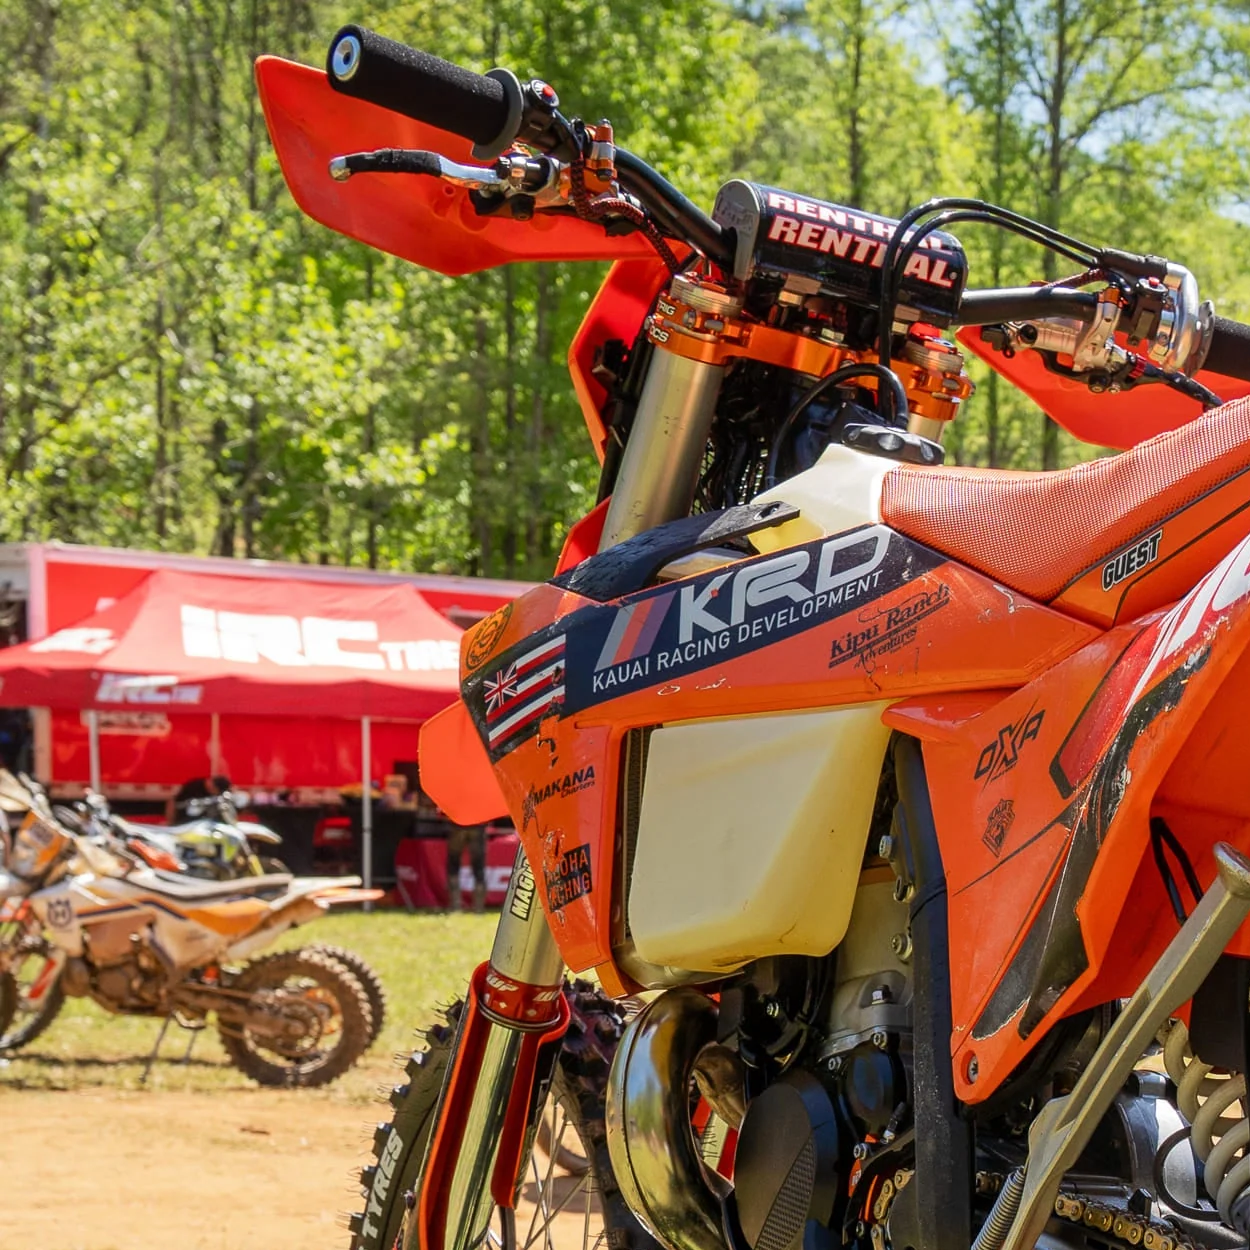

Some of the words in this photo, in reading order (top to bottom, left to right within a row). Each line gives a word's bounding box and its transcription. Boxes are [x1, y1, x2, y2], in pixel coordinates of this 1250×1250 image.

[678, 523, 892, 645] KRD
[1102, 529, 1163, 591] GUEST
[592, 657, 650, 692] KAUAI
[657, 631, 730, 671] RACING
[738, 570, 883, 643] DEVELOPMENT
[830, 624, 879, 659] Kipu
[886, 583, 949, 631] Ranch
[854, 626, 917, 669] Adventures
[533, 766, 595, 806] MAKANA
[362, 1128, 403, 1239] TYRES
